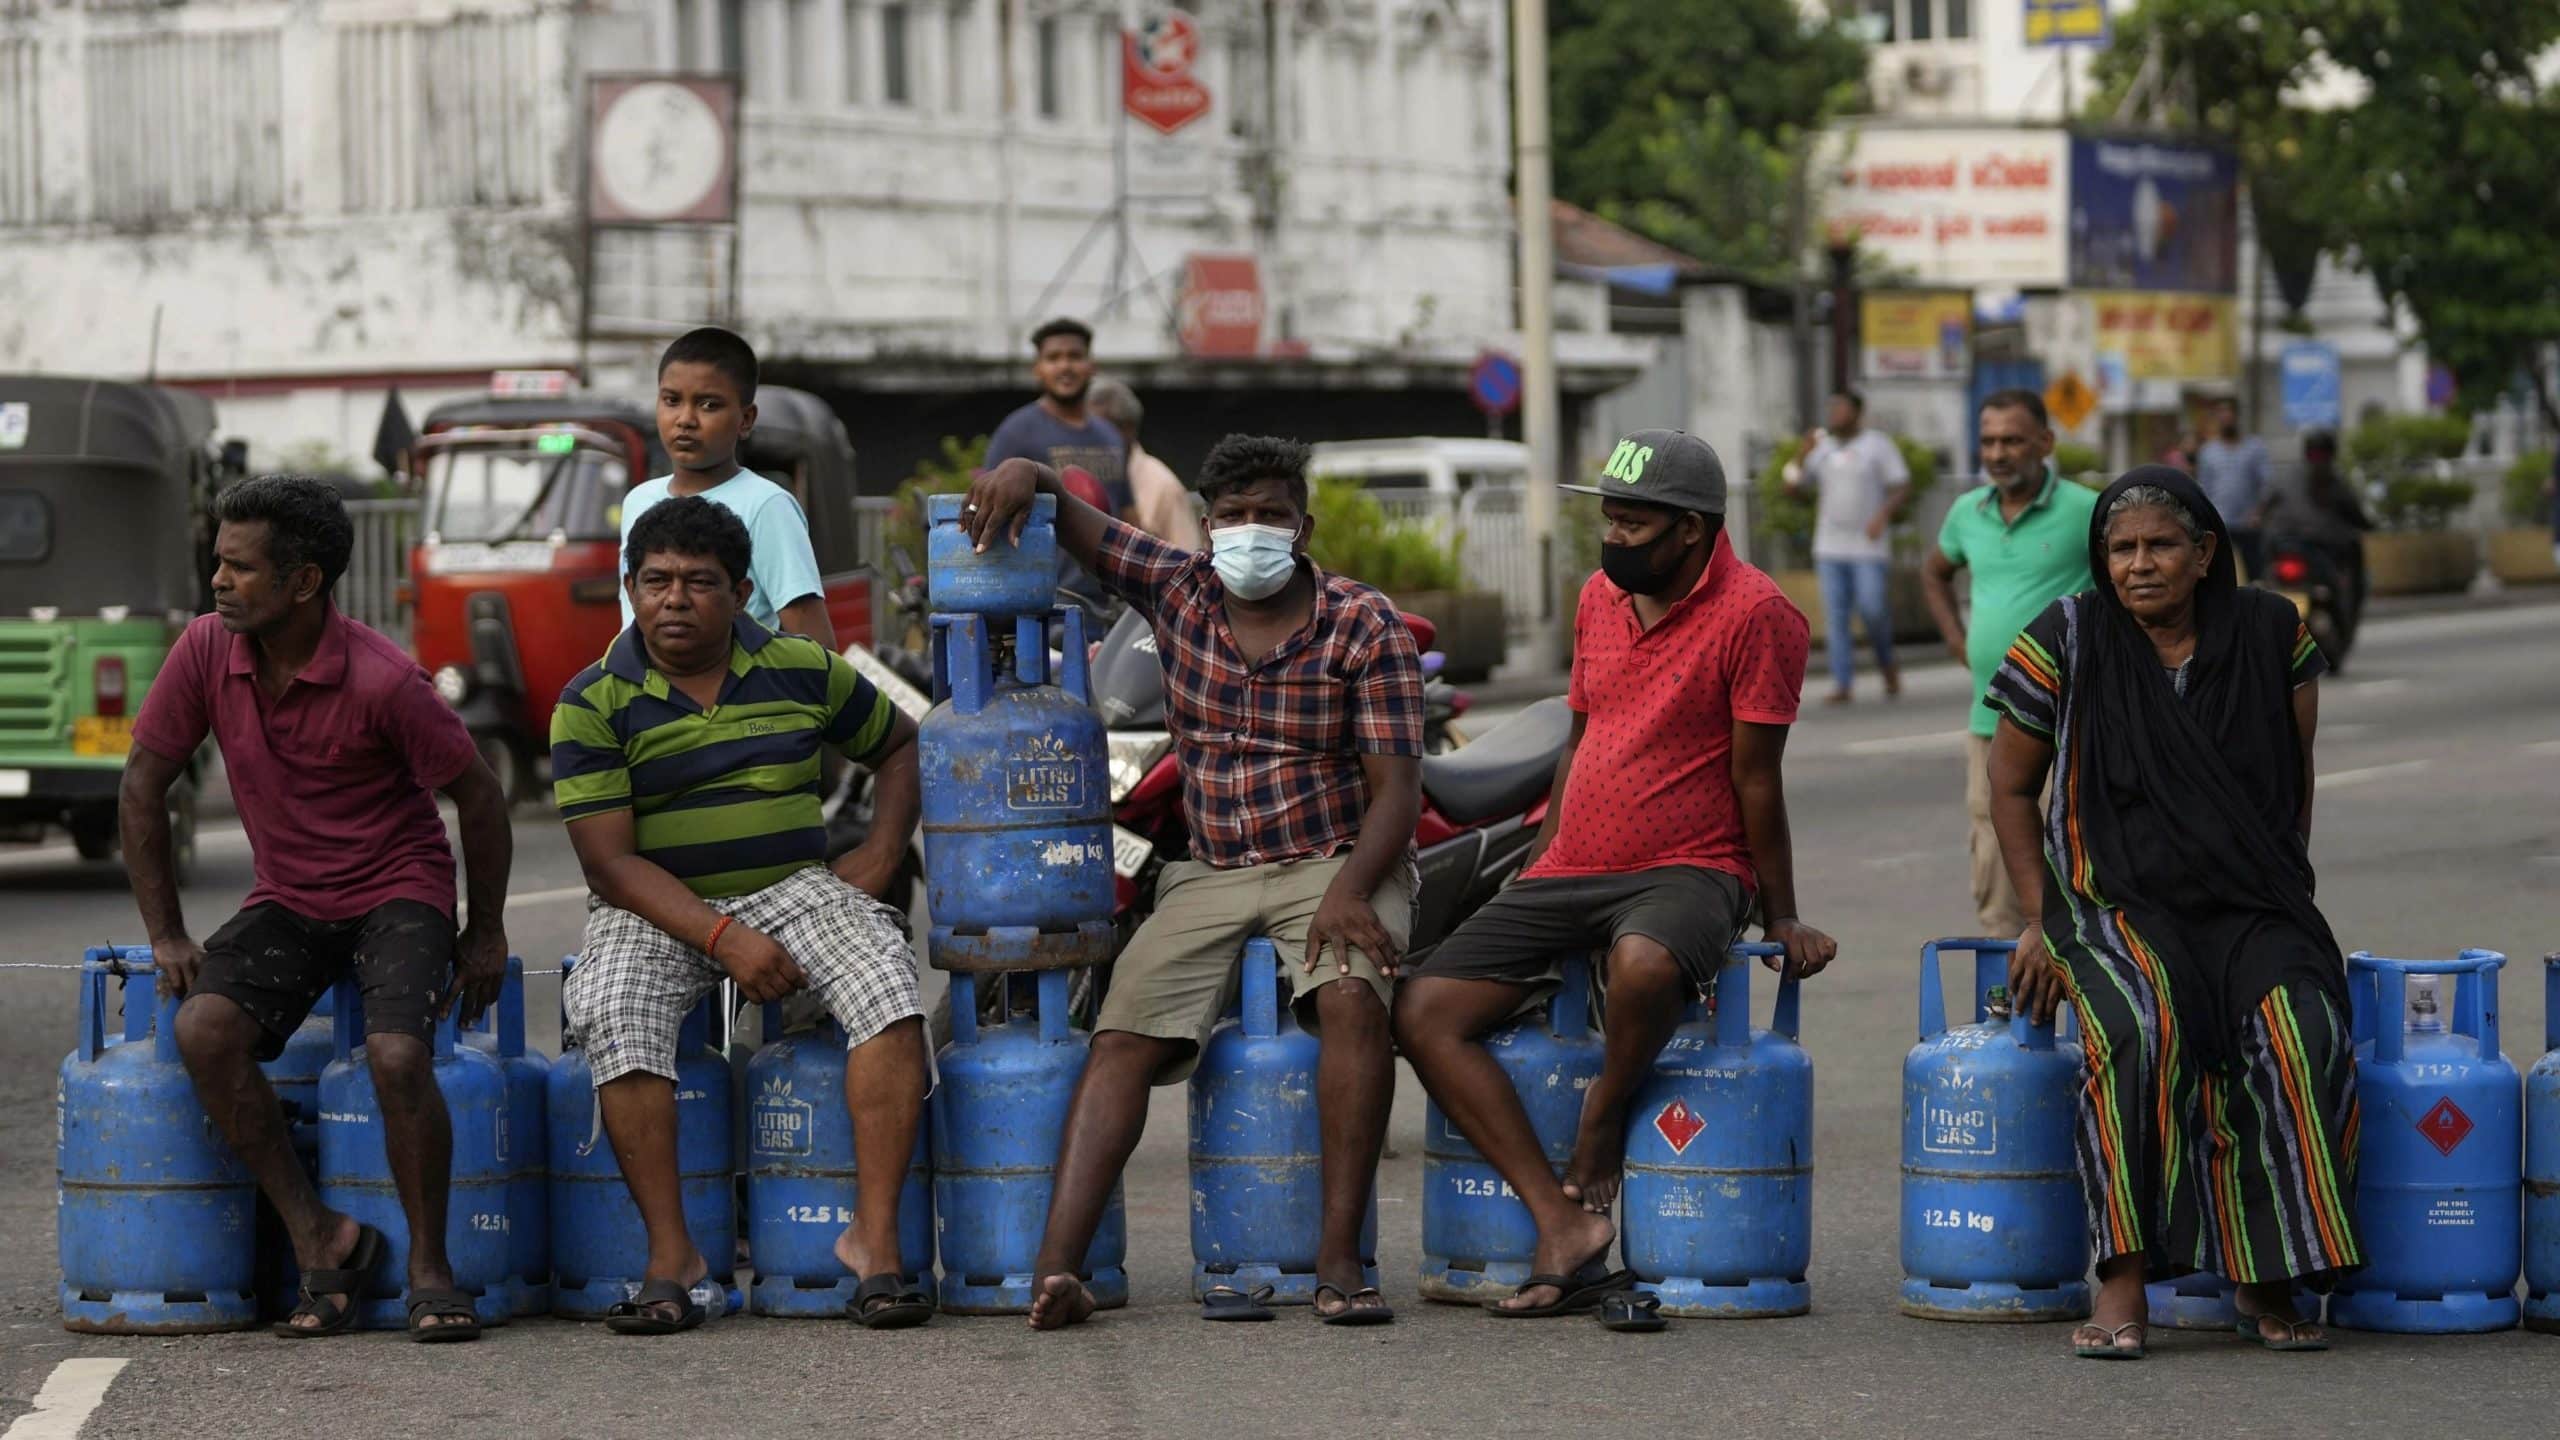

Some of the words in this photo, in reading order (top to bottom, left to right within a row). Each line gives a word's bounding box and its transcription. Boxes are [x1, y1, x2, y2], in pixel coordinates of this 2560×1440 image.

[1018, 767, 1076, 785] LITRO
[1025, 785, 1069, 802] GAS
[1723, 1069, 1737, 1081] Vol
[758, 1111, 802, 1131] LITRO
[761, 1130, 794, 1149] GAS
[1453, 1178, 1496, 1198] 12.5
[1501, 1181, 1521, 1200] k
[472, 1213, 501, 1231] 12.5
[787, 1205, 832, 1223] 12.5
[1924, 1208, 1961, 1229] 12.5
[1967, 1210, 1995, 1233] kg
[2428, 1209, 2475, 1217] EXTREMELY
[2428, 1218, 2476, 1226] FLAMMABLE
